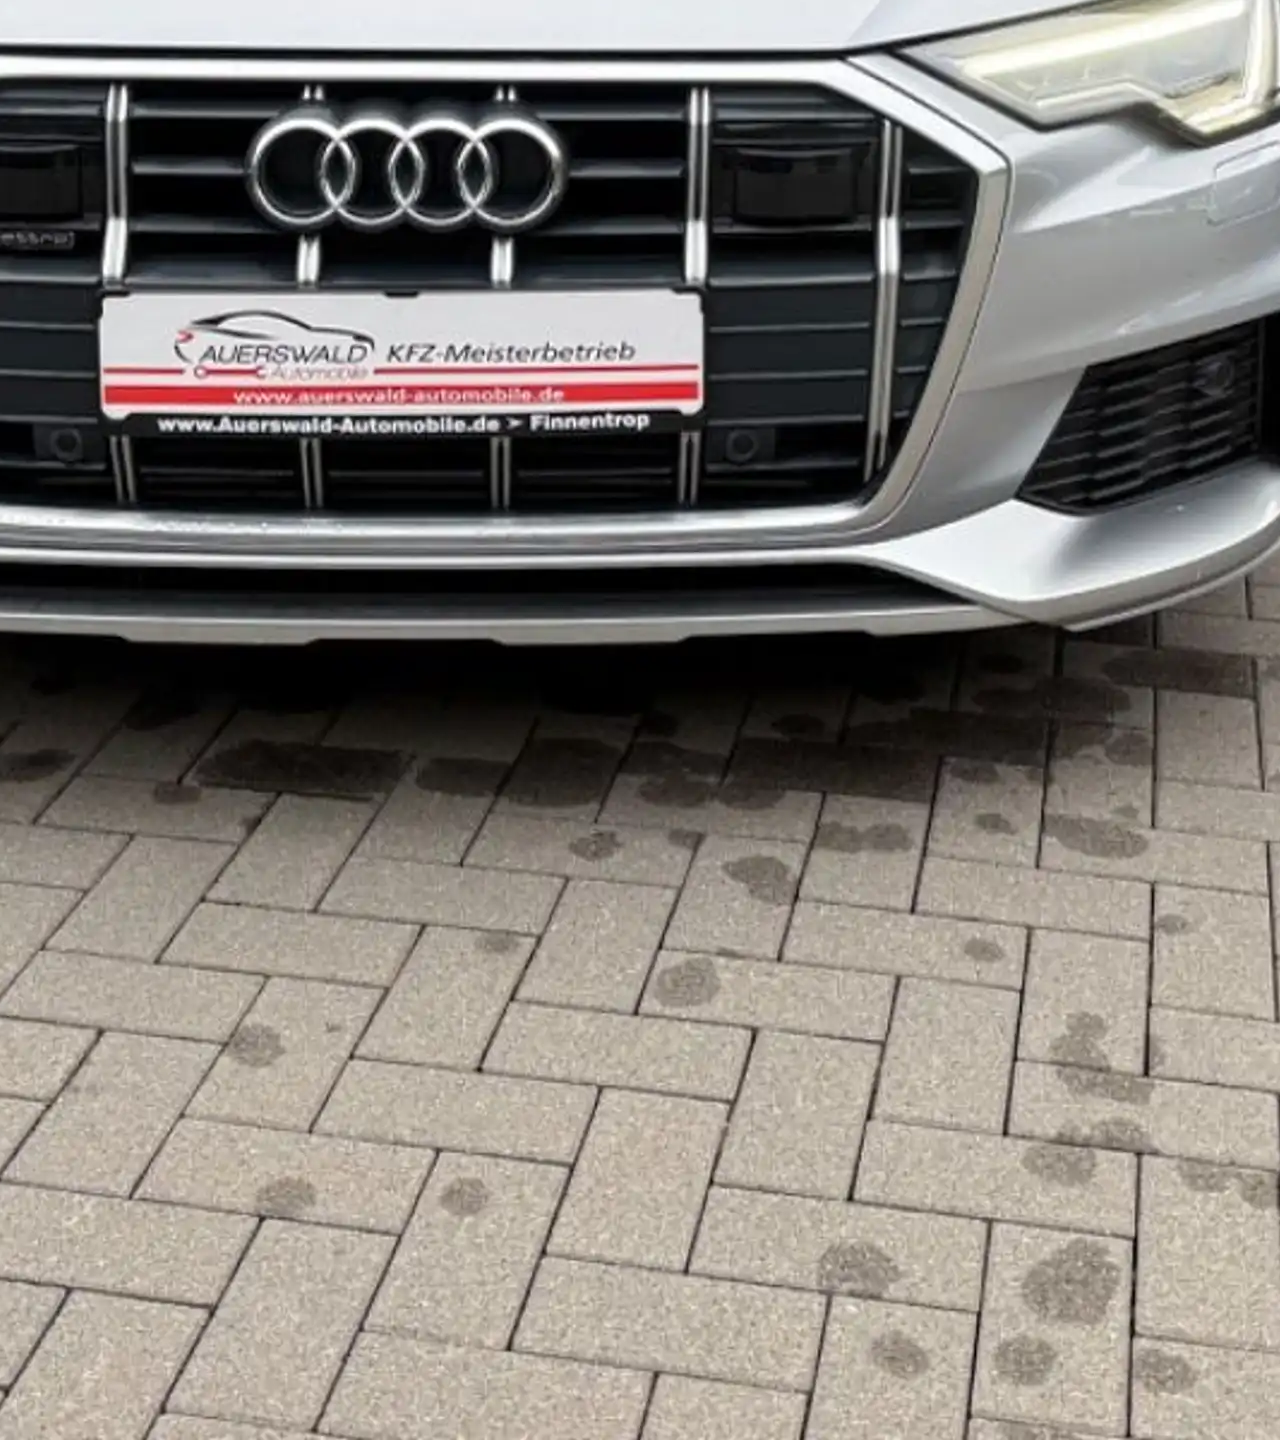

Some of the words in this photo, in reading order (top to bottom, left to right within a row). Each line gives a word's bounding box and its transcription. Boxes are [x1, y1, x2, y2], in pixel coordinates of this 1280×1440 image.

[200, 343, 369, 364] AUERSWALD
[387, 341, 636, 364] KFZ-Meisterbetrieb
[233, 387, 565, 405] www.auerswald-automobile.de
[158, 415, 500, 434] www.Auerswald-Automobile.de
[530, 412, 651, 432] Finnentrop
